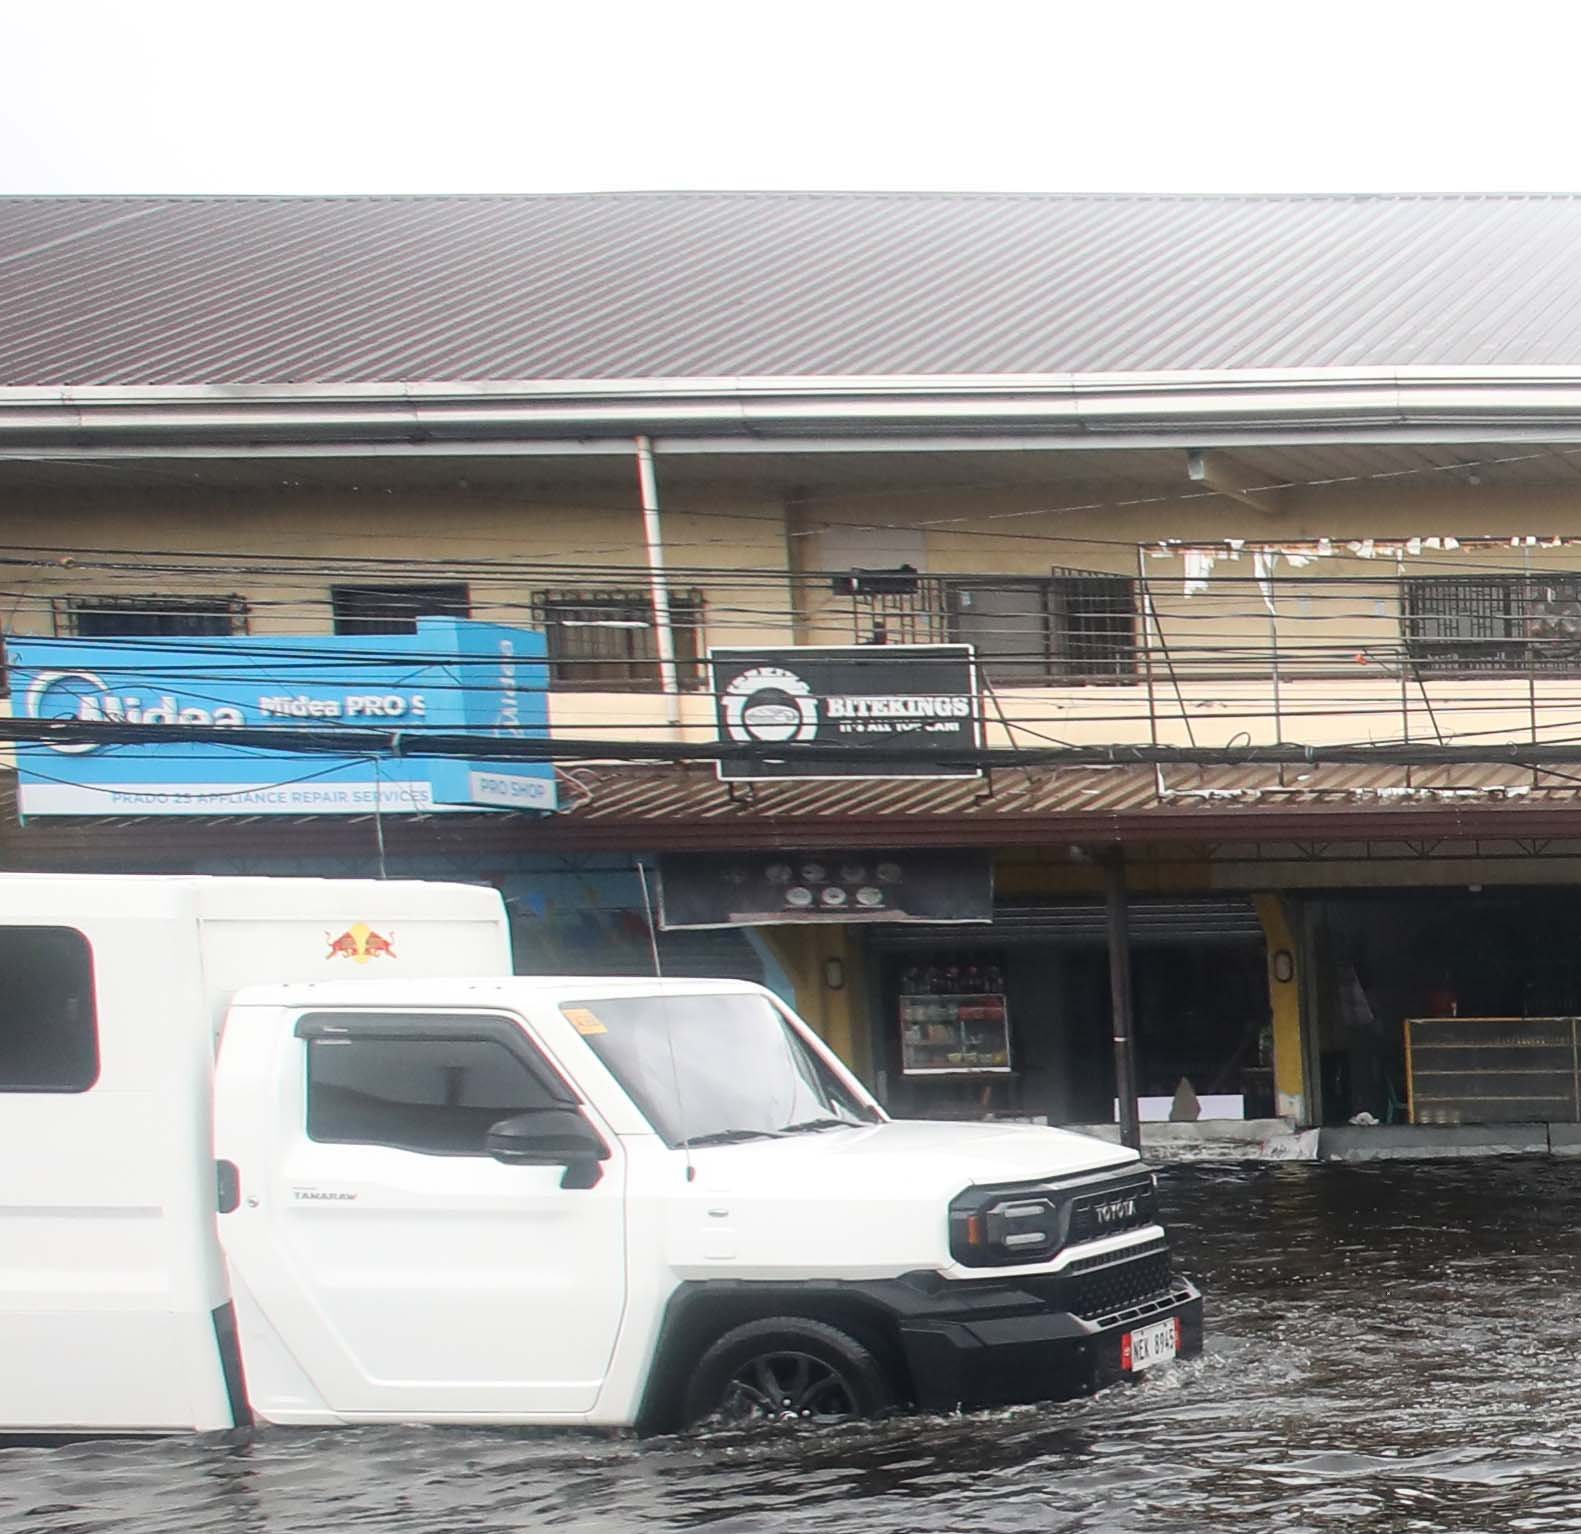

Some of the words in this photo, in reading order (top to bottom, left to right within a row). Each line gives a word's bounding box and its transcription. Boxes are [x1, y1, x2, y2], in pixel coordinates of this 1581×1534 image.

[259, 695, 341, 717] Midea
[345, 694, 408, 717] PRO
[825, 695, 970, 718] BITEKINGS
[112, 792, 168, 804] PRADO
[197, 792, 289, 805] APPLIANCE
[293, 791, 351, 804] REPAIR
[354, 790, 430, 804] SERVICES
[479, 777, 507, 793] PRO
[512, 780, 546, 798] SHOP
[1096, 1200, 1136, 1223] TOYOTA
